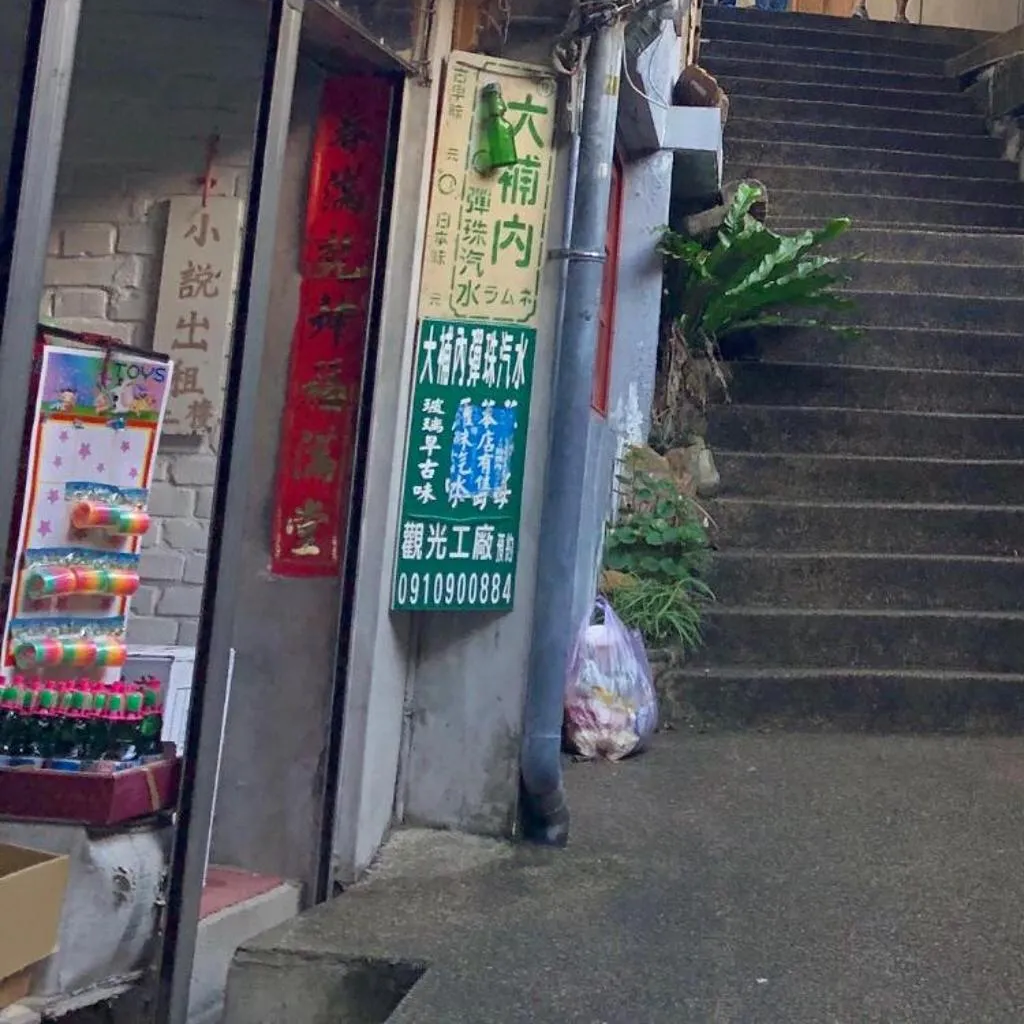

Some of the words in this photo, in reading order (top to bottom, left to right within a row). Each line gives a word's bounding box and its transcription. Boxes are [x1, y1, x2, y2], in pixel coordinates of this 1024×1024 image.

[456, 185, 491, 307] 彈珠汽水
[171, 212, 220, 398] 小說出租
[483, 284, 533, 307] ラムネ
[113, 362, 167, 384] TOYS
[402, 521, 495, 560] 觀光工廠
[398, 572, 512, 605] 0910900884
